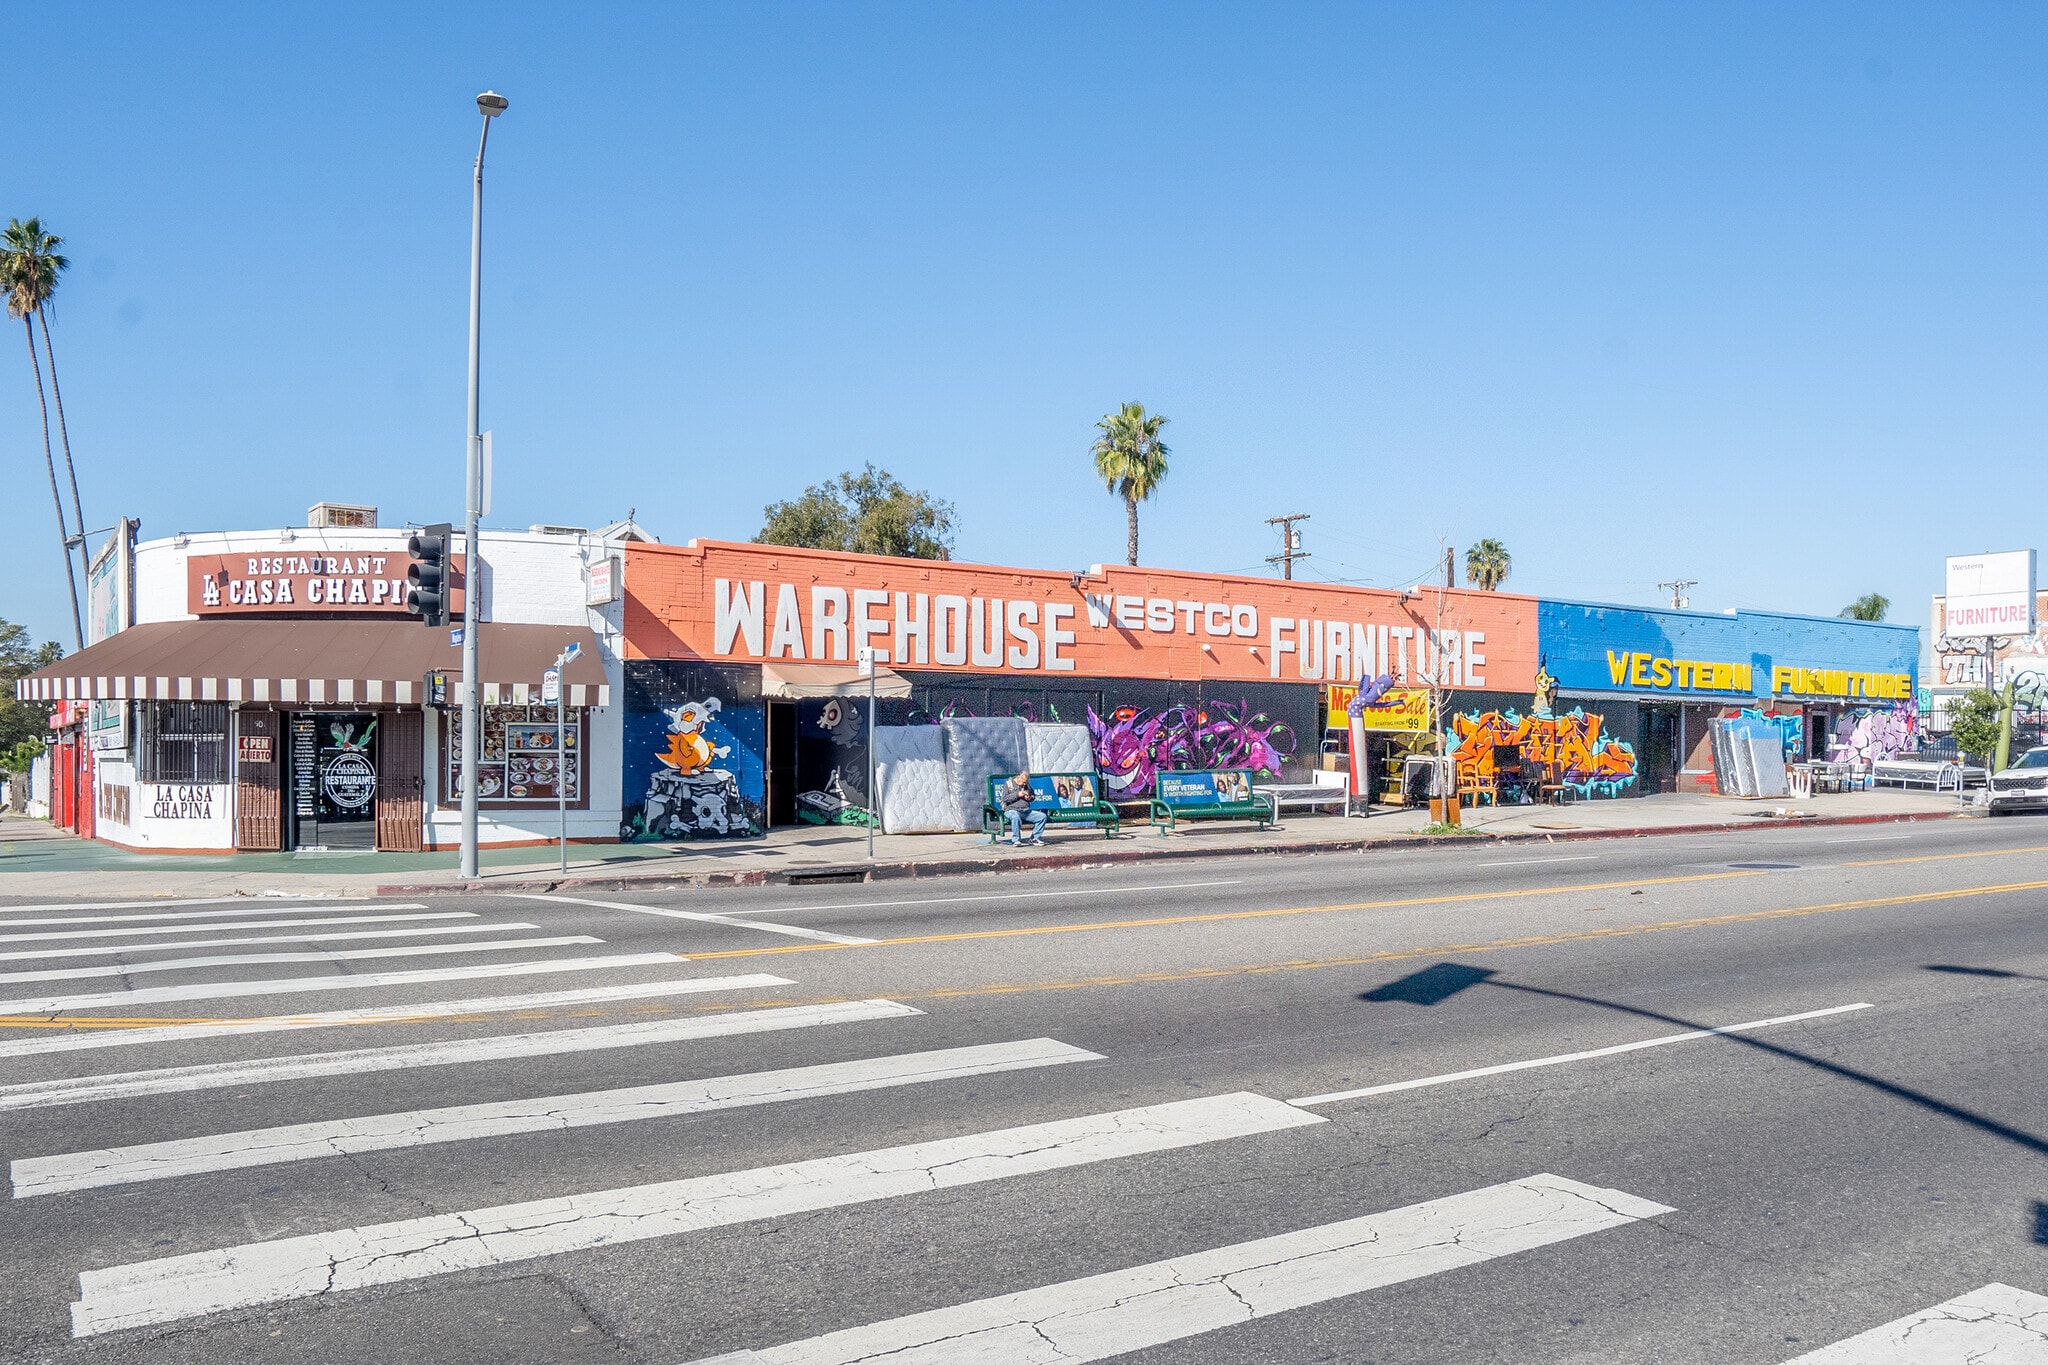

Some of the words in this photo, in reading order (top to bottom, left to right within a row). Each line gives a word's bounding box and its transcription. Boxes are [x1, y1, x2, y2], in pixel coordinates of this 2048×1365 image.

[247, 556, 386, 576] RESTAURANT
[1952, 563, 1984, 571] Western
[203, 574, 220, 606] LA
[229, 578, 295, 605] CASA
[307, 578, 423, 605] CHAPI
[1947, 604, 2027, 626] FURNITURE
[714, 578, 1076, 671] WAREHOUSE
[1085, 592, 1258, 637] WESTCO
[1270, 617, 1486, 687] FURNITURE
[1606, 650, 1752, 692] WESTERN
[1772, 665, 1912, 699] FURNITURE
[1331, 686, 1392, 714] Matss
[1395, 692, 1427, 716] Sale
[243, 738, 269, 749] OPEN
[325, 776, 376, 785] RESTAURANTE
[156, 785, 174, 802] LA
[178, 785, 213, 802] CASA
[153, 801, 212, 819] CHAPINA
